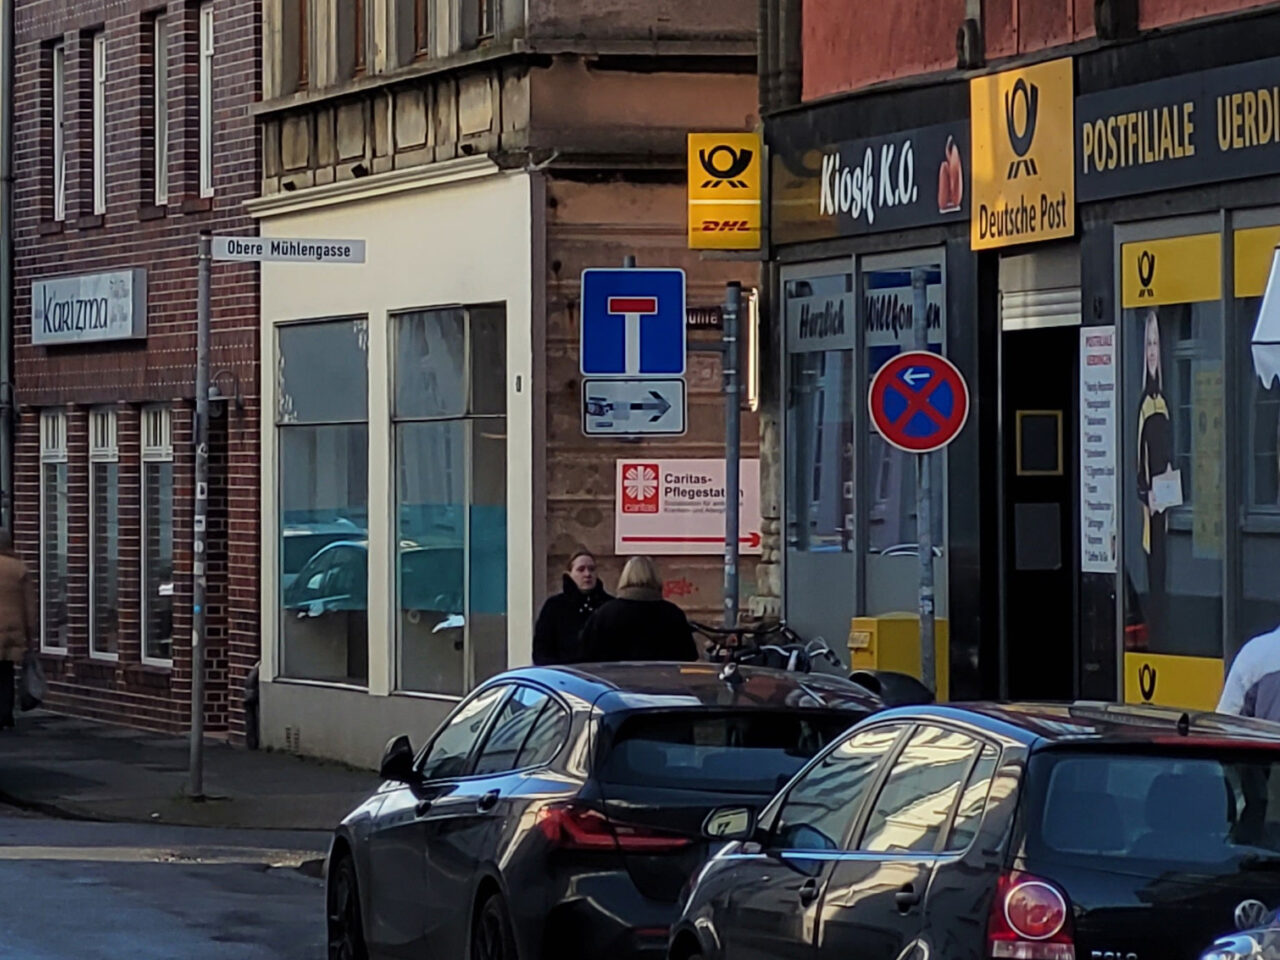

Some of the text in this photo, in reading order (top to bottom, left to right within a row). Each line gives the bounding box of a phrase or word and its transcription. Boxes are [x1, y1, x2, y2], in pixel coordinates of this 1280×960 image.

[1083, 102, 1195, 174] POSTFILIALE
[820, 140, 918, 224] Kiosk K.O.
[980, 191, 1066, 240] Deutsche Post
[702, 221, 751, 231] DHL
[227, 240, 351, 260] Obere Mühlengasse
[664, 473, 713, 484] Caritas-
[664, 487, 744, 500] Pflegestatn
